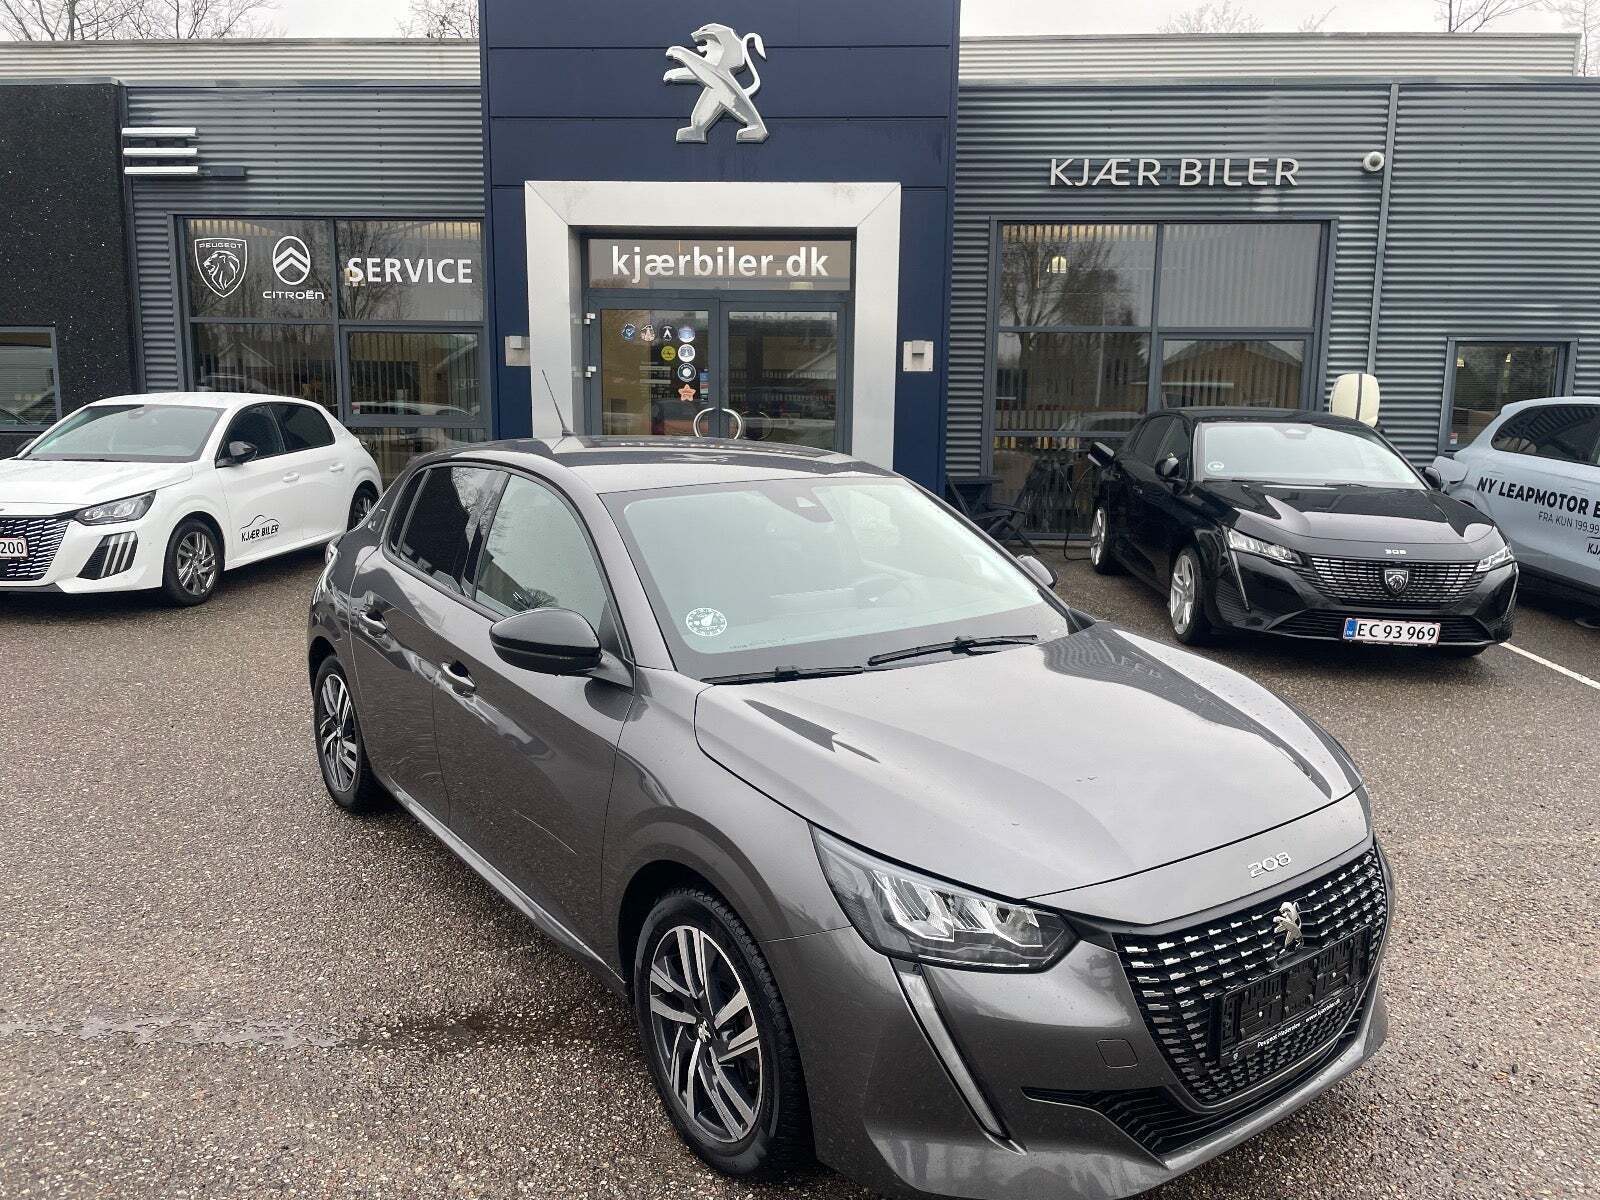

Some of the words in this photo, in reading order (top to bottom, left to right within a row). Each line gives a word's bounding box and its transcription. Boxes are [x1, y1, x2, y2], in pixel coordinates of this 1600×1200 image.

[1049, 158, 1161, 187] KJÆR
[1178, 158, 1300, 188] BILER
[197, 241, 243, 249] PEUGEOT
[346, 256, 473, 285] SERVICE
[611, 244, 829, 284] kjærbiler.dk
[1476, 476, 1498, 494] NY
[1498, 481, 1590, 516] LEAPMOTOR
[1538, 511, 1554, 525] FRA
[1555, 517, 1573, 528] KUN
[241, 529, 260, 542] KJÆR
[261, 524, 280, 537] BILER
[0, 541, 24, 554] 200
[1356, 623, 1380, 638] EC
[1383, 624, 1403, 639] 93
[1406, 626, 1436, 641] 969
[1247, 852, 1292, 878] 208
